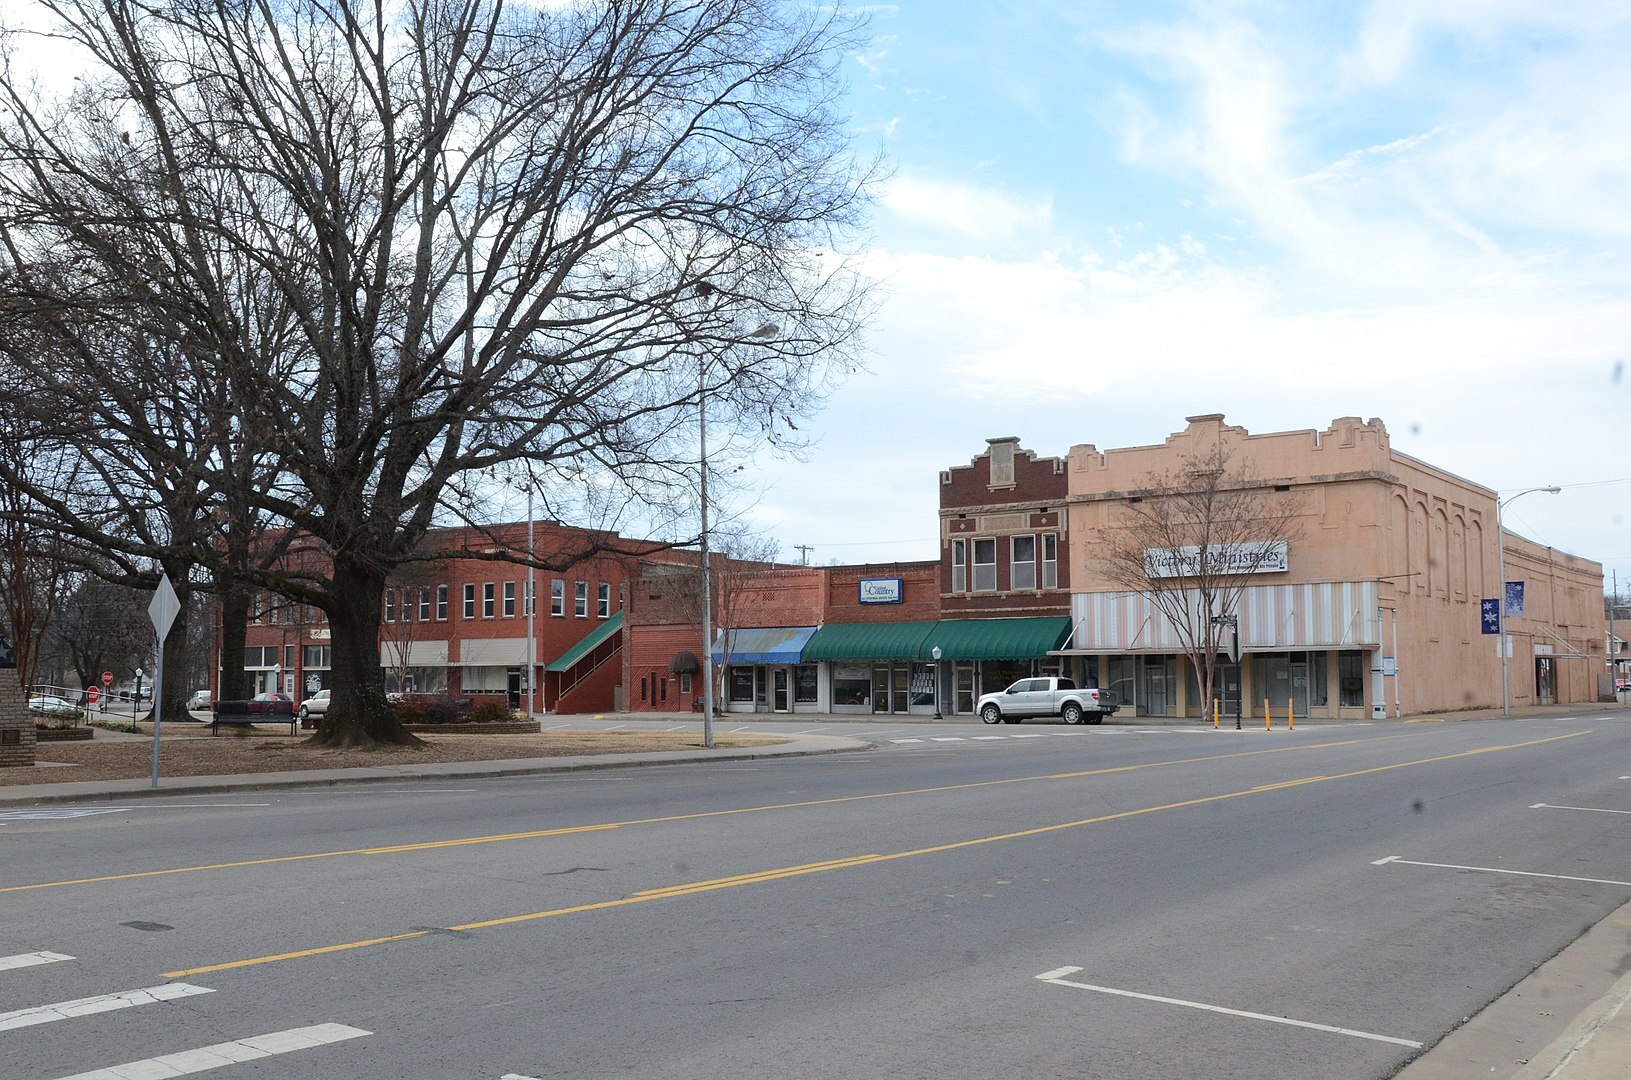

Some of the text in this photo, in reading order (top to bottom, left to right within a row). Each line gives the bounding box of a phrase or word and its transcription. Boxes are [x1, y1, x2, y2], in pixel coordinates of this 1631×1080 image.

[1146, 550, 1279, 572] Victory Ministries
[869, 586, 894, 596] Country
